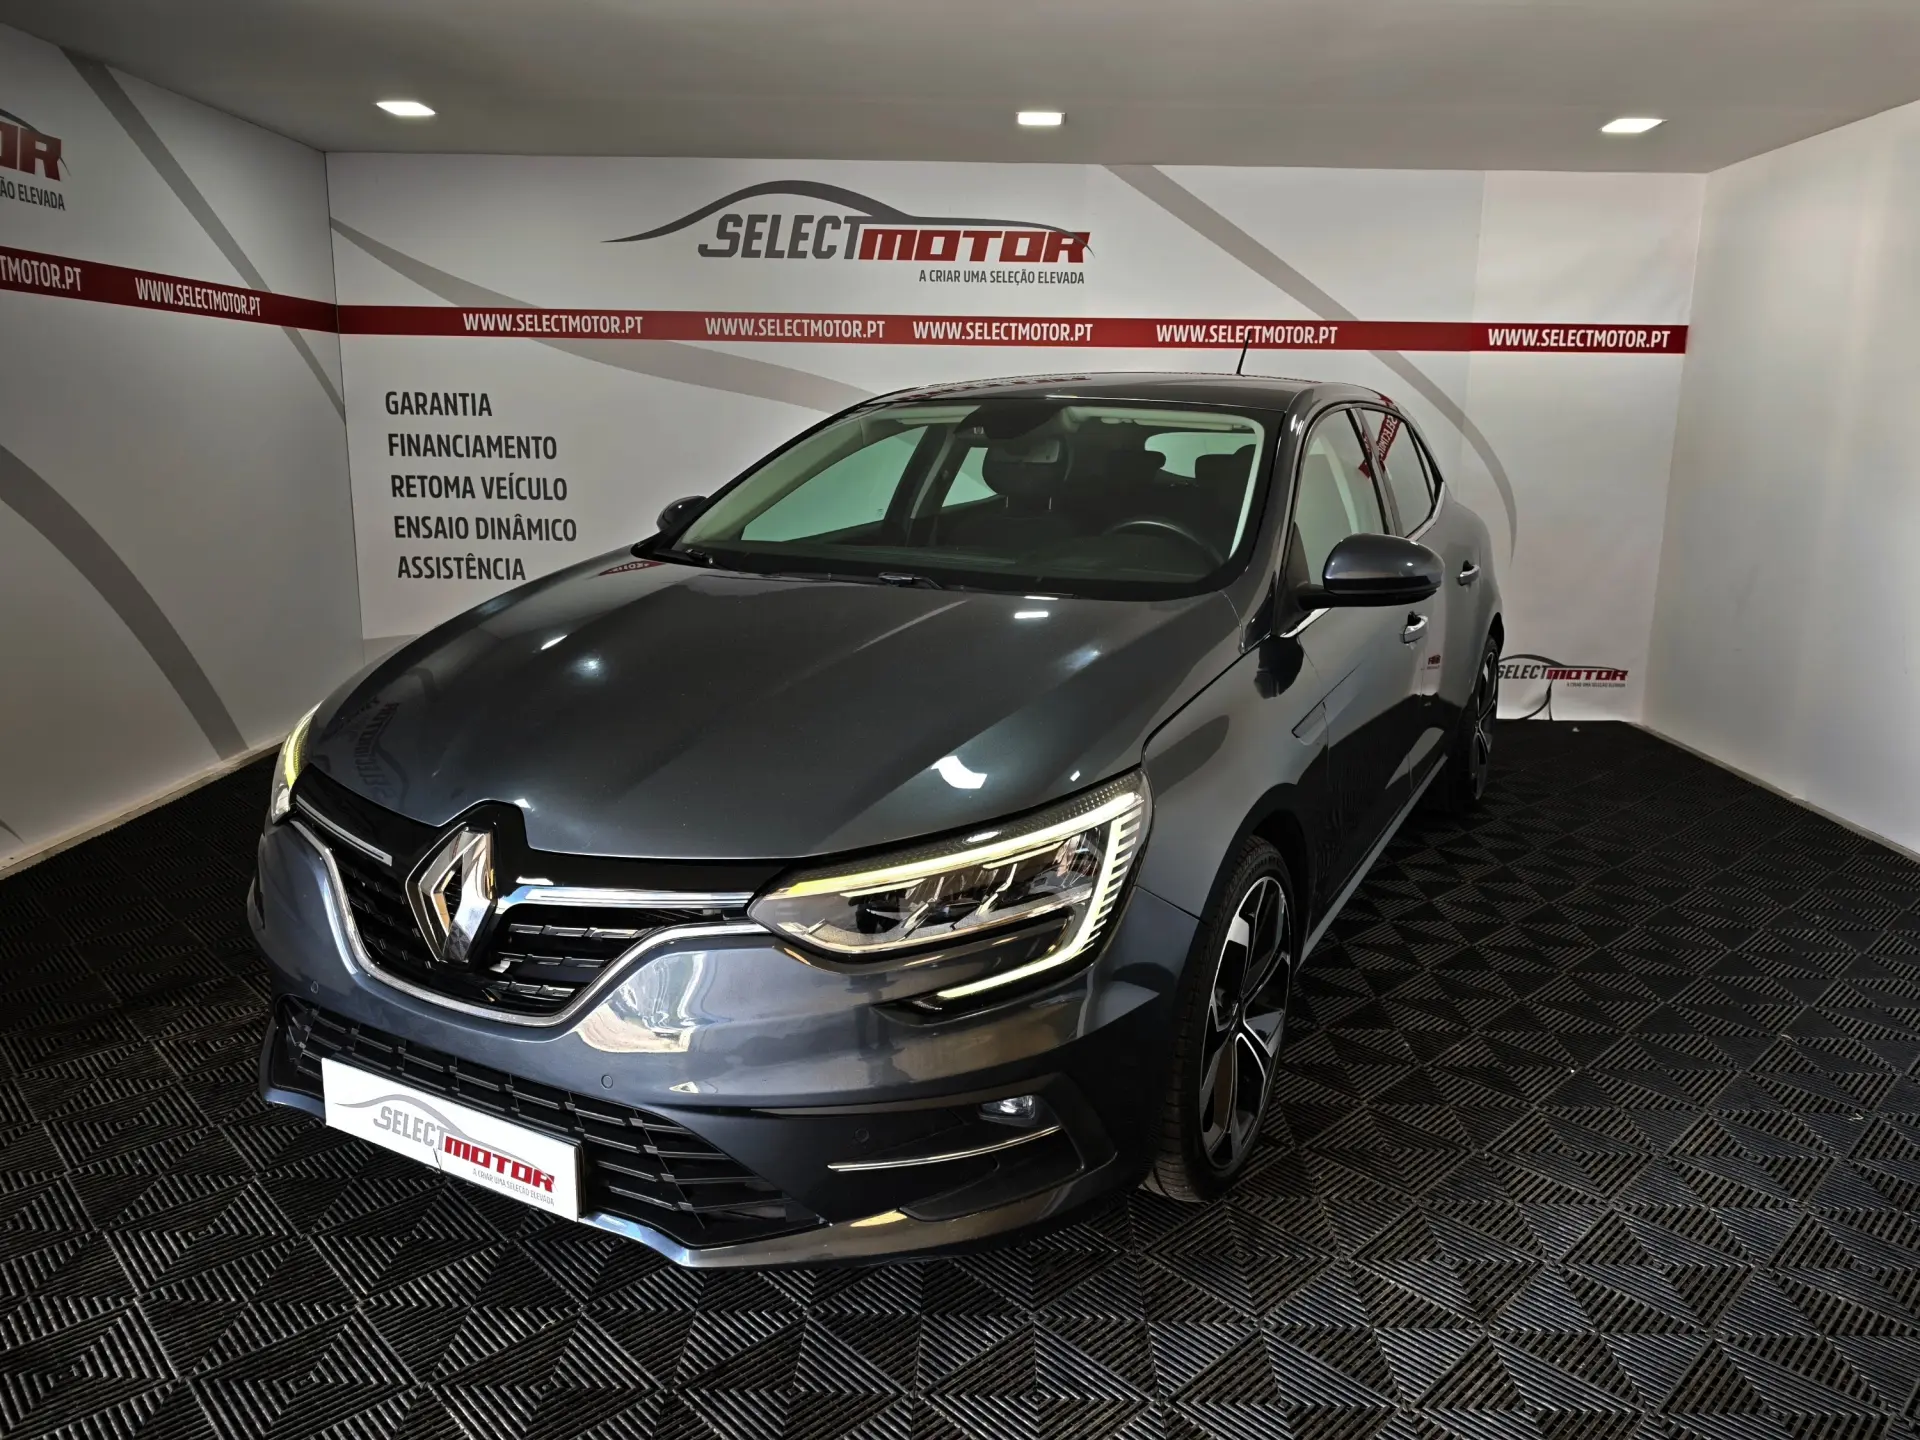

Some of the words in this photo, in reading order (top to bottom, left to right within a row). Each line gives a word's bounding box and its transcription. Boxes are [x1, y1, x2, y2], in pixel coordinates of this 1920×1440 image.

[18, 183, 66, 211] ELEVADA
[919, 269, 927, 282] A
[929, 269, 961, 283] CRIAR
[963, 270, 987, 283] UMA
[989, 268, 1035, 286] SELEÇÃO
[1037, 271, 1085, 284] ELEVADA
[134, 276, 261, 316] WWW.SELECTMOTOR.PT
[462, 312, 643, 335] WWW.SELECTMOTOR.PT
[704, 316, 885, 339] WWW.SELECTMOTOR.PT
[912, 320, 1093, 342] WWW.SELECTMOTOR.PT
[1156, 323, 1338, 345] WWW.SELECTMOTOR.PT
[1487, 327, 1671, 348] WWW.SELECTMOTOR.PT
[384, 390, 493, 417] GARANTIA
[387, 432, 558, 460] FINANCIAMENTO
[390, 474, 476, 499] RETOMA
[480, 472, 568, 501] VEÍCULO
[393, 515, 470, 540] ENSAIO
[475, 513, 578, 541] DINÂMICO
[397, 553, 527, 581] ASSISTÊNCIA
